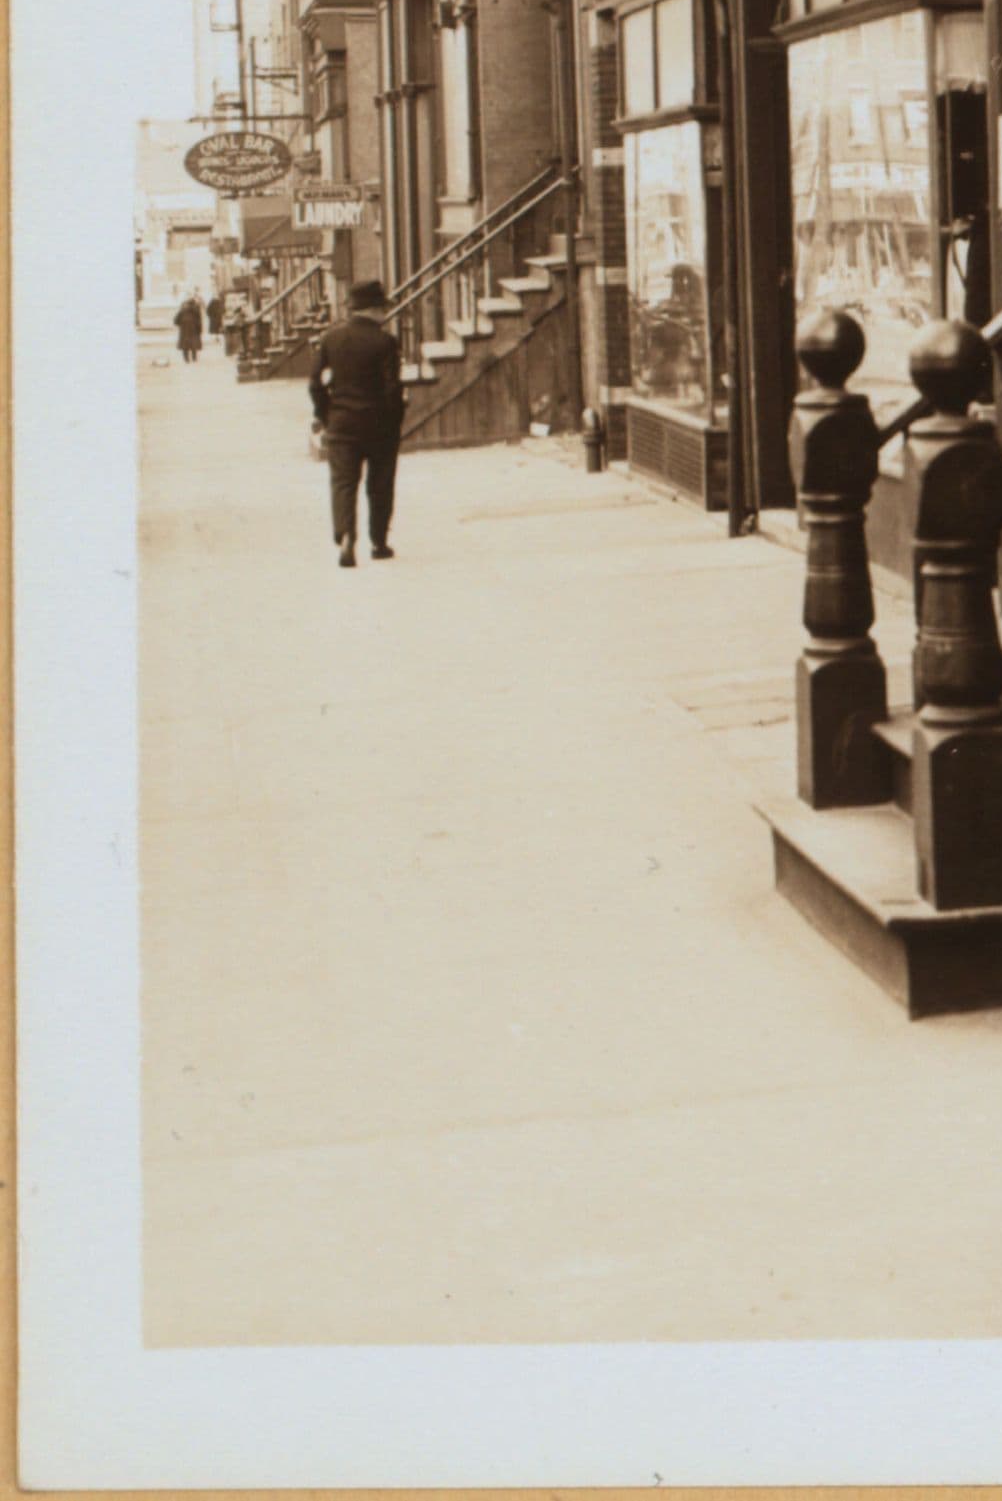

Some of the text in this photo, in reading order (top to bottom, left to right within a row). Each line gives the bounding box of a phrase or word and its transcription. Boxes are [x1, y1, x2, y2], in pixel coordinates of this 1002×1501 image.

[199, 134, 275, 156] OVAL BAR
[295, 201, 364, 227] LAUNDRY
